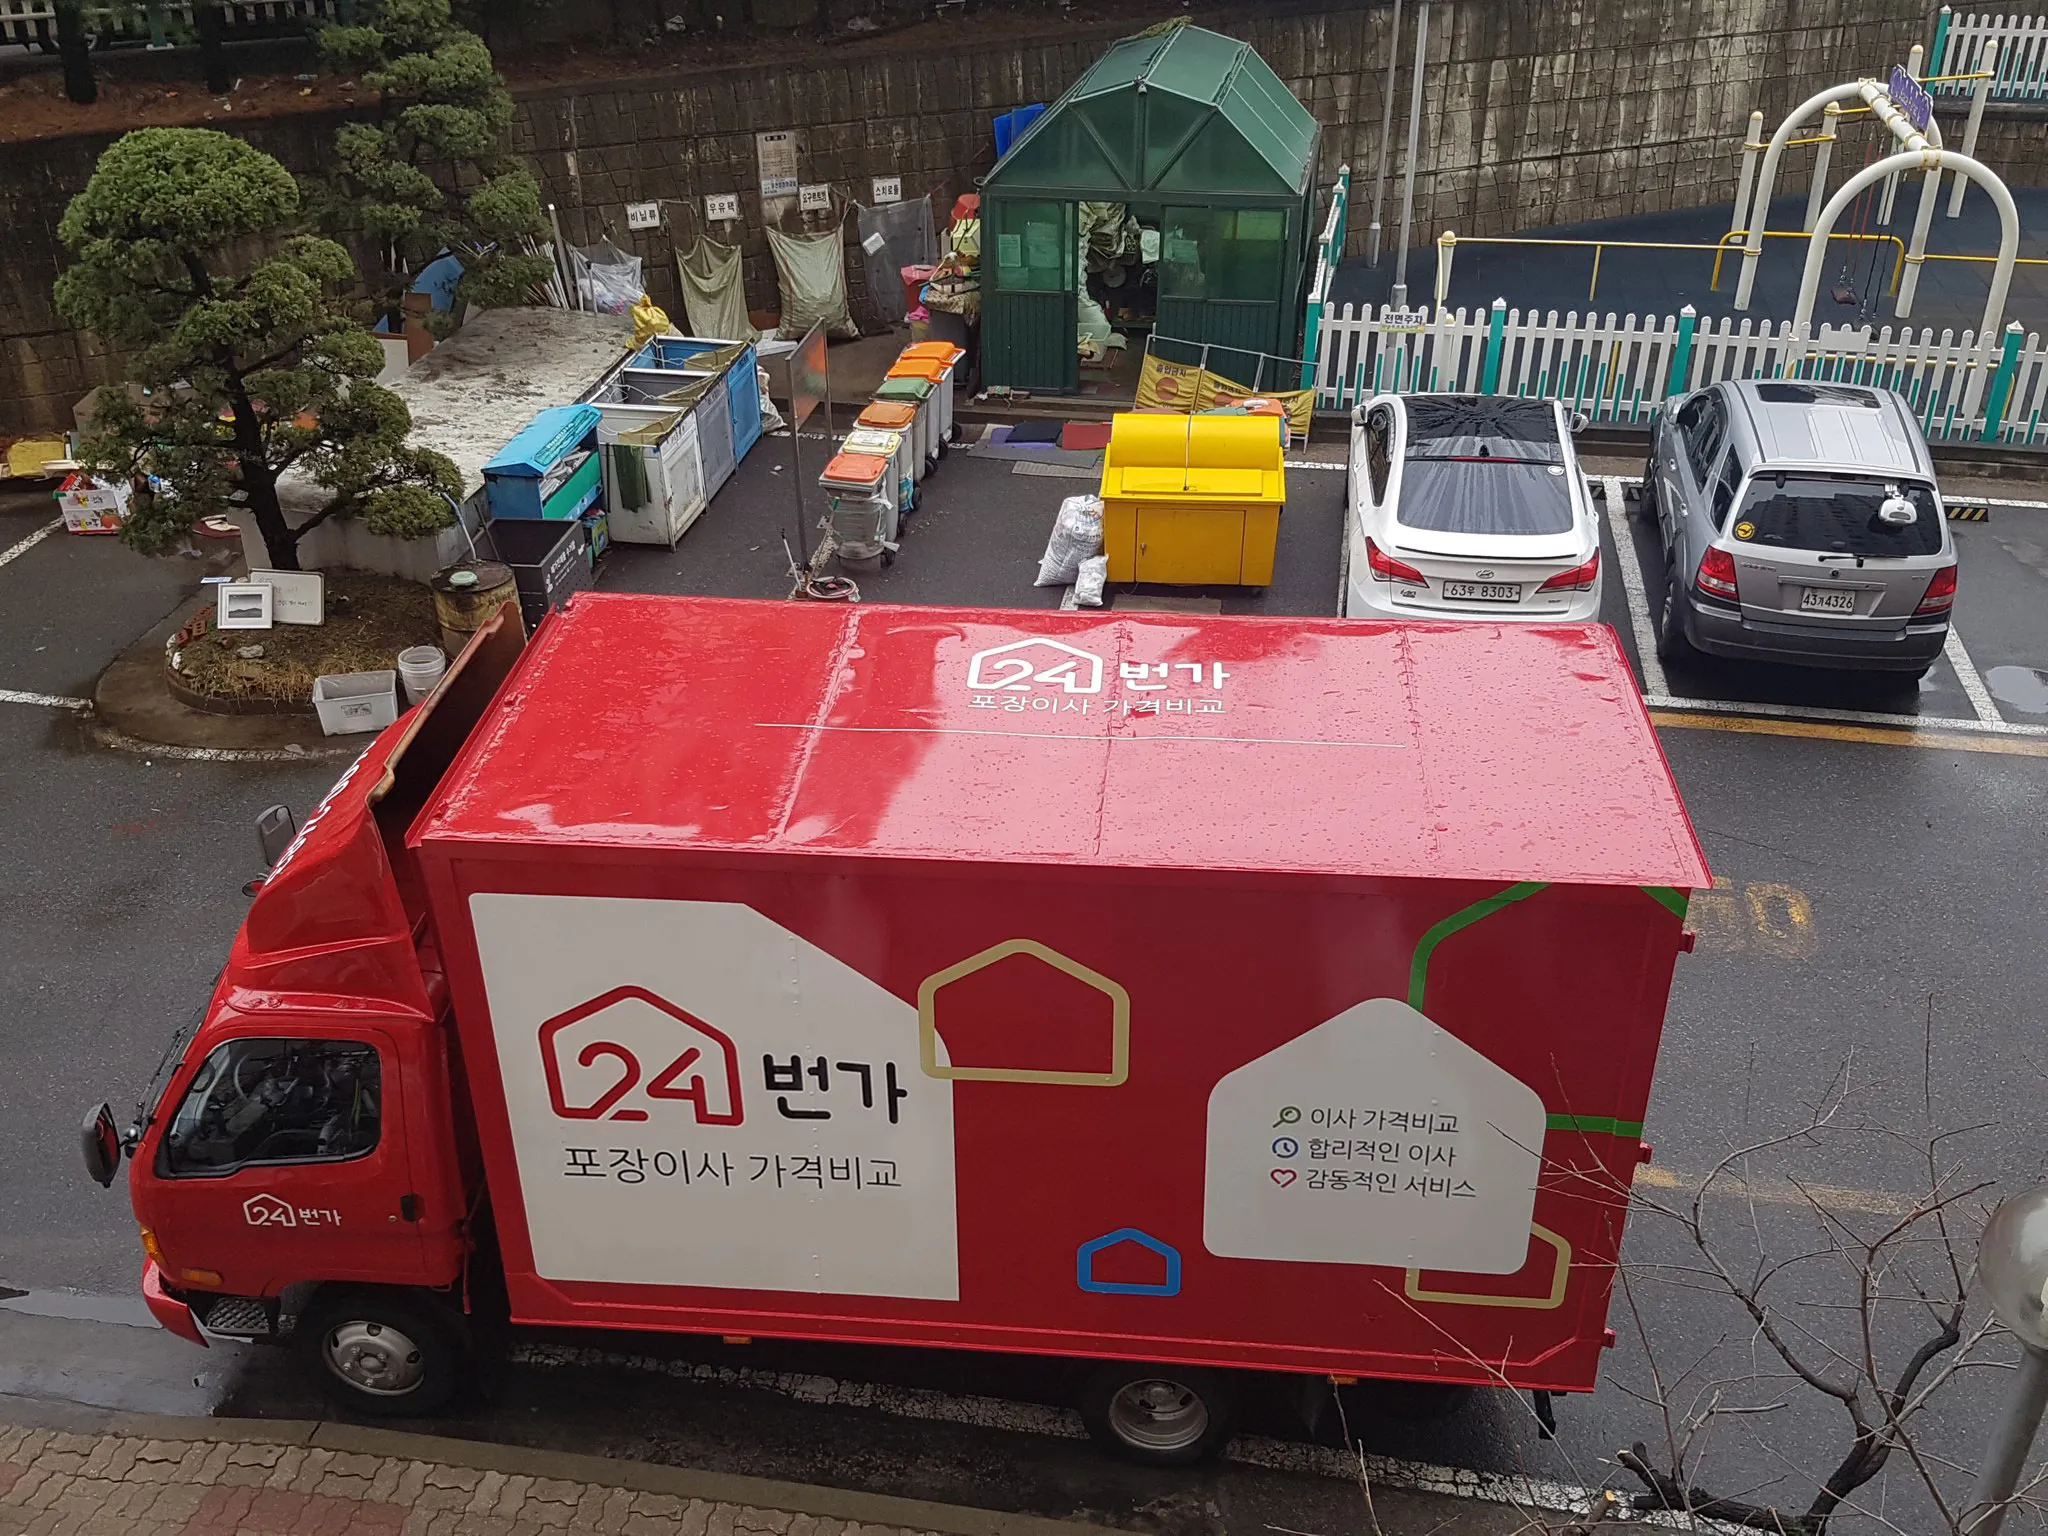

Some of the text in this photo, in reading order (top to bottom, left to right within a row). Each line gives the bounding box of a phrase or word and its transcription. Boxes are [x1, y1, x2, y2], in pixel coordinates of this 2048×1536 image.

[630, 209, 657, 222] 비닐류
[709, 201, 735, 215] 우유팩
[1384, 314, 1423, 325] 전면주차
[1156, 364, 1187, 377] 출입금지
[1450, 579, 1514, 599] 63우 8303
[967, 694, 1227, 717] 포장이사 가격비교
[1310, 1107, 1461, 1135] 이사 가격비교
[1307, 1137, 1457, 1168] 합리적인 이사
[563, 1146, 902, 1191] 포장이사 가격비교
[1305, 1168, 1478, 1199] 감동적인 서비스
